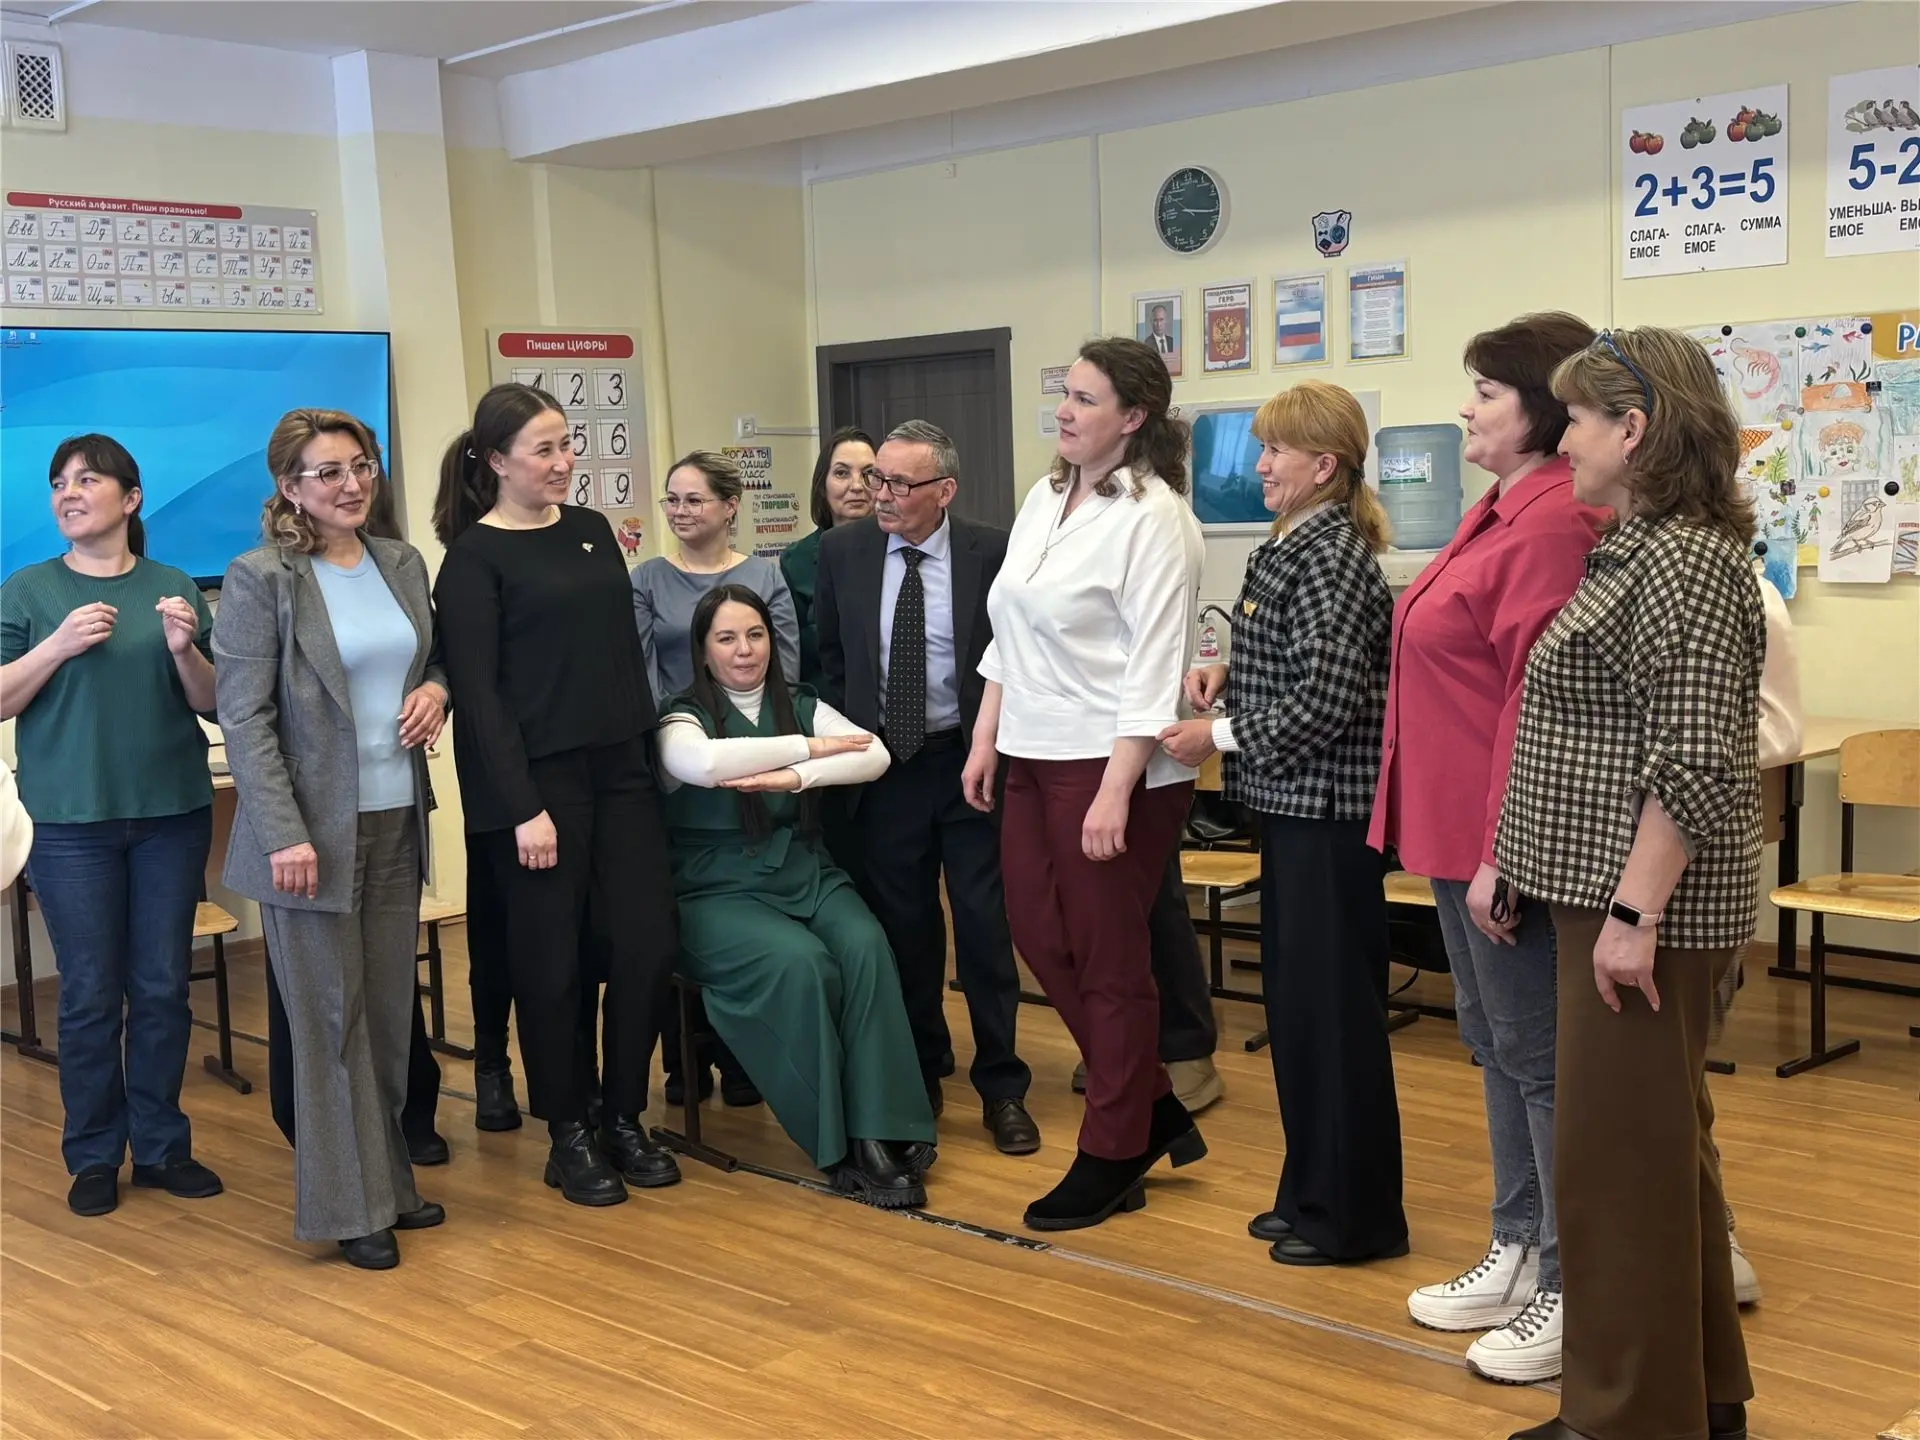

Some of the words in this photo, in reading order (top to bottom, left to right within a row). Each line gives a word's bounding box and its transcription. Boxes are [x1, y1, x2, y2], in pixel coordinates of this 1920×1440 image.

[48, 198, 87, 209] Русский
[88, 200, 130, 211] алфавит.
[132, 203, 157, 212] Пиши
[159, 206, 207, 216] правильно!
[1829, 201, 1896, 220] УМЕНЬША-
[1630, 228, 1669, 243] СЛАГА-
[1685, 222, 1725, 237] СЛАГА-
[1740, 215, 1781, 231] СУММА
[1829, 223, 1864, 238] ЕМОЕ
[1630, 245, 1660, 259] ЕМОЕ
[1684, 240, 1716, 254] ЕМОЕ
[526, 339, 565, 351] Пишем
[567, 340, 608, 352] ЦИФРЫ
[569, 373, 585, 405] 2
[608, 373, 623, 405] 3
[573, 423, 588, 456] 5
[611, 423, 627, 455] 6
[575, 473, 590, 505] 8
[615, 473, 630, 504] 9
